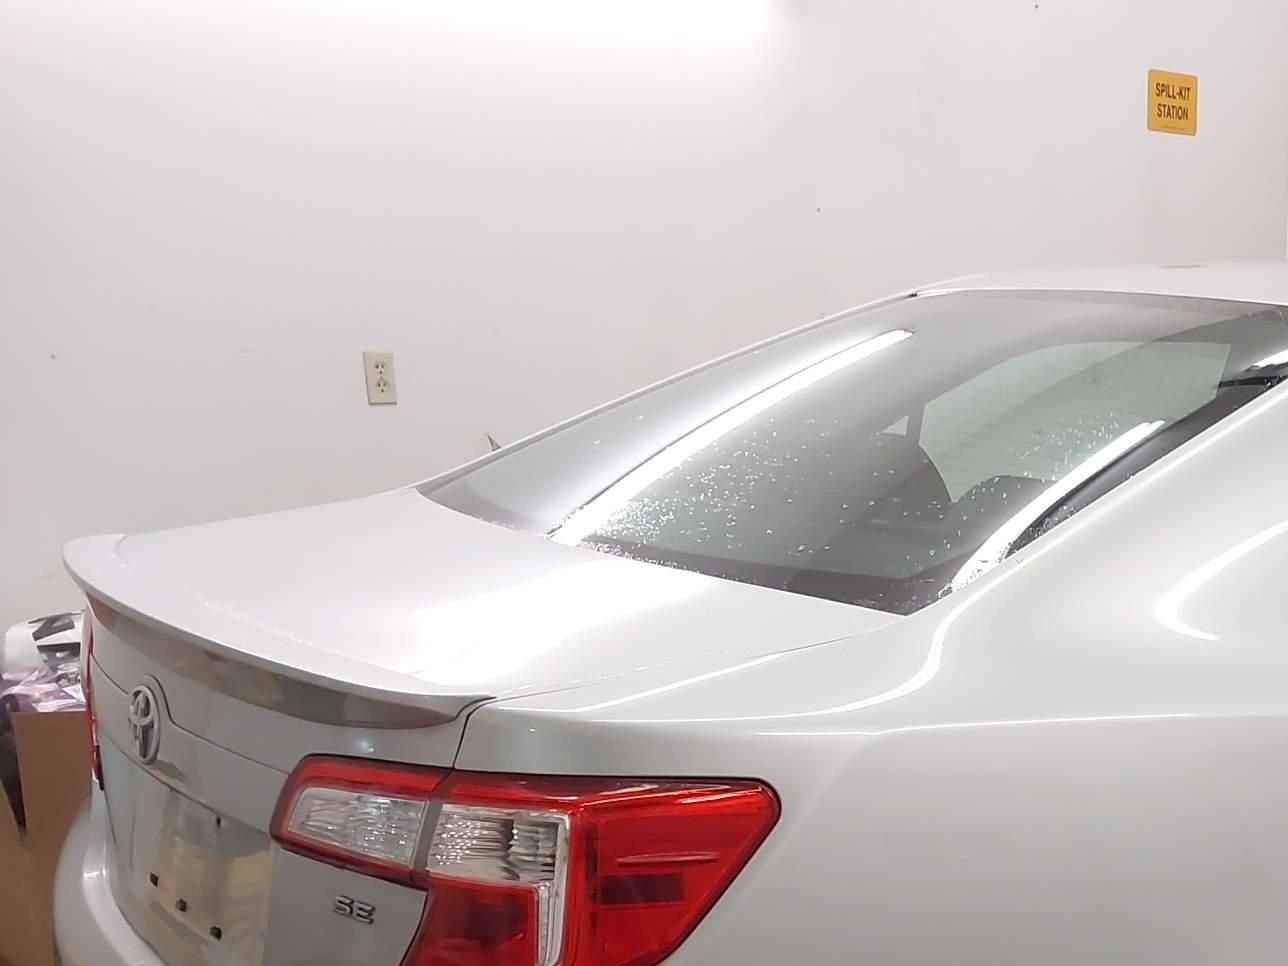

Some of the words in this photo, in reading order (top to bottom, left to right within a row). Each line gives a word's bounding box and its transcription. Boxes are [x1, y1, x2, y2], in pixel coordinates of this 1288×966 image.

[1155, 82, 1191, 101] SPILL-KIT
[1156, 102, 1189, 121] STATION
[334, 894, 376, 925] SE
